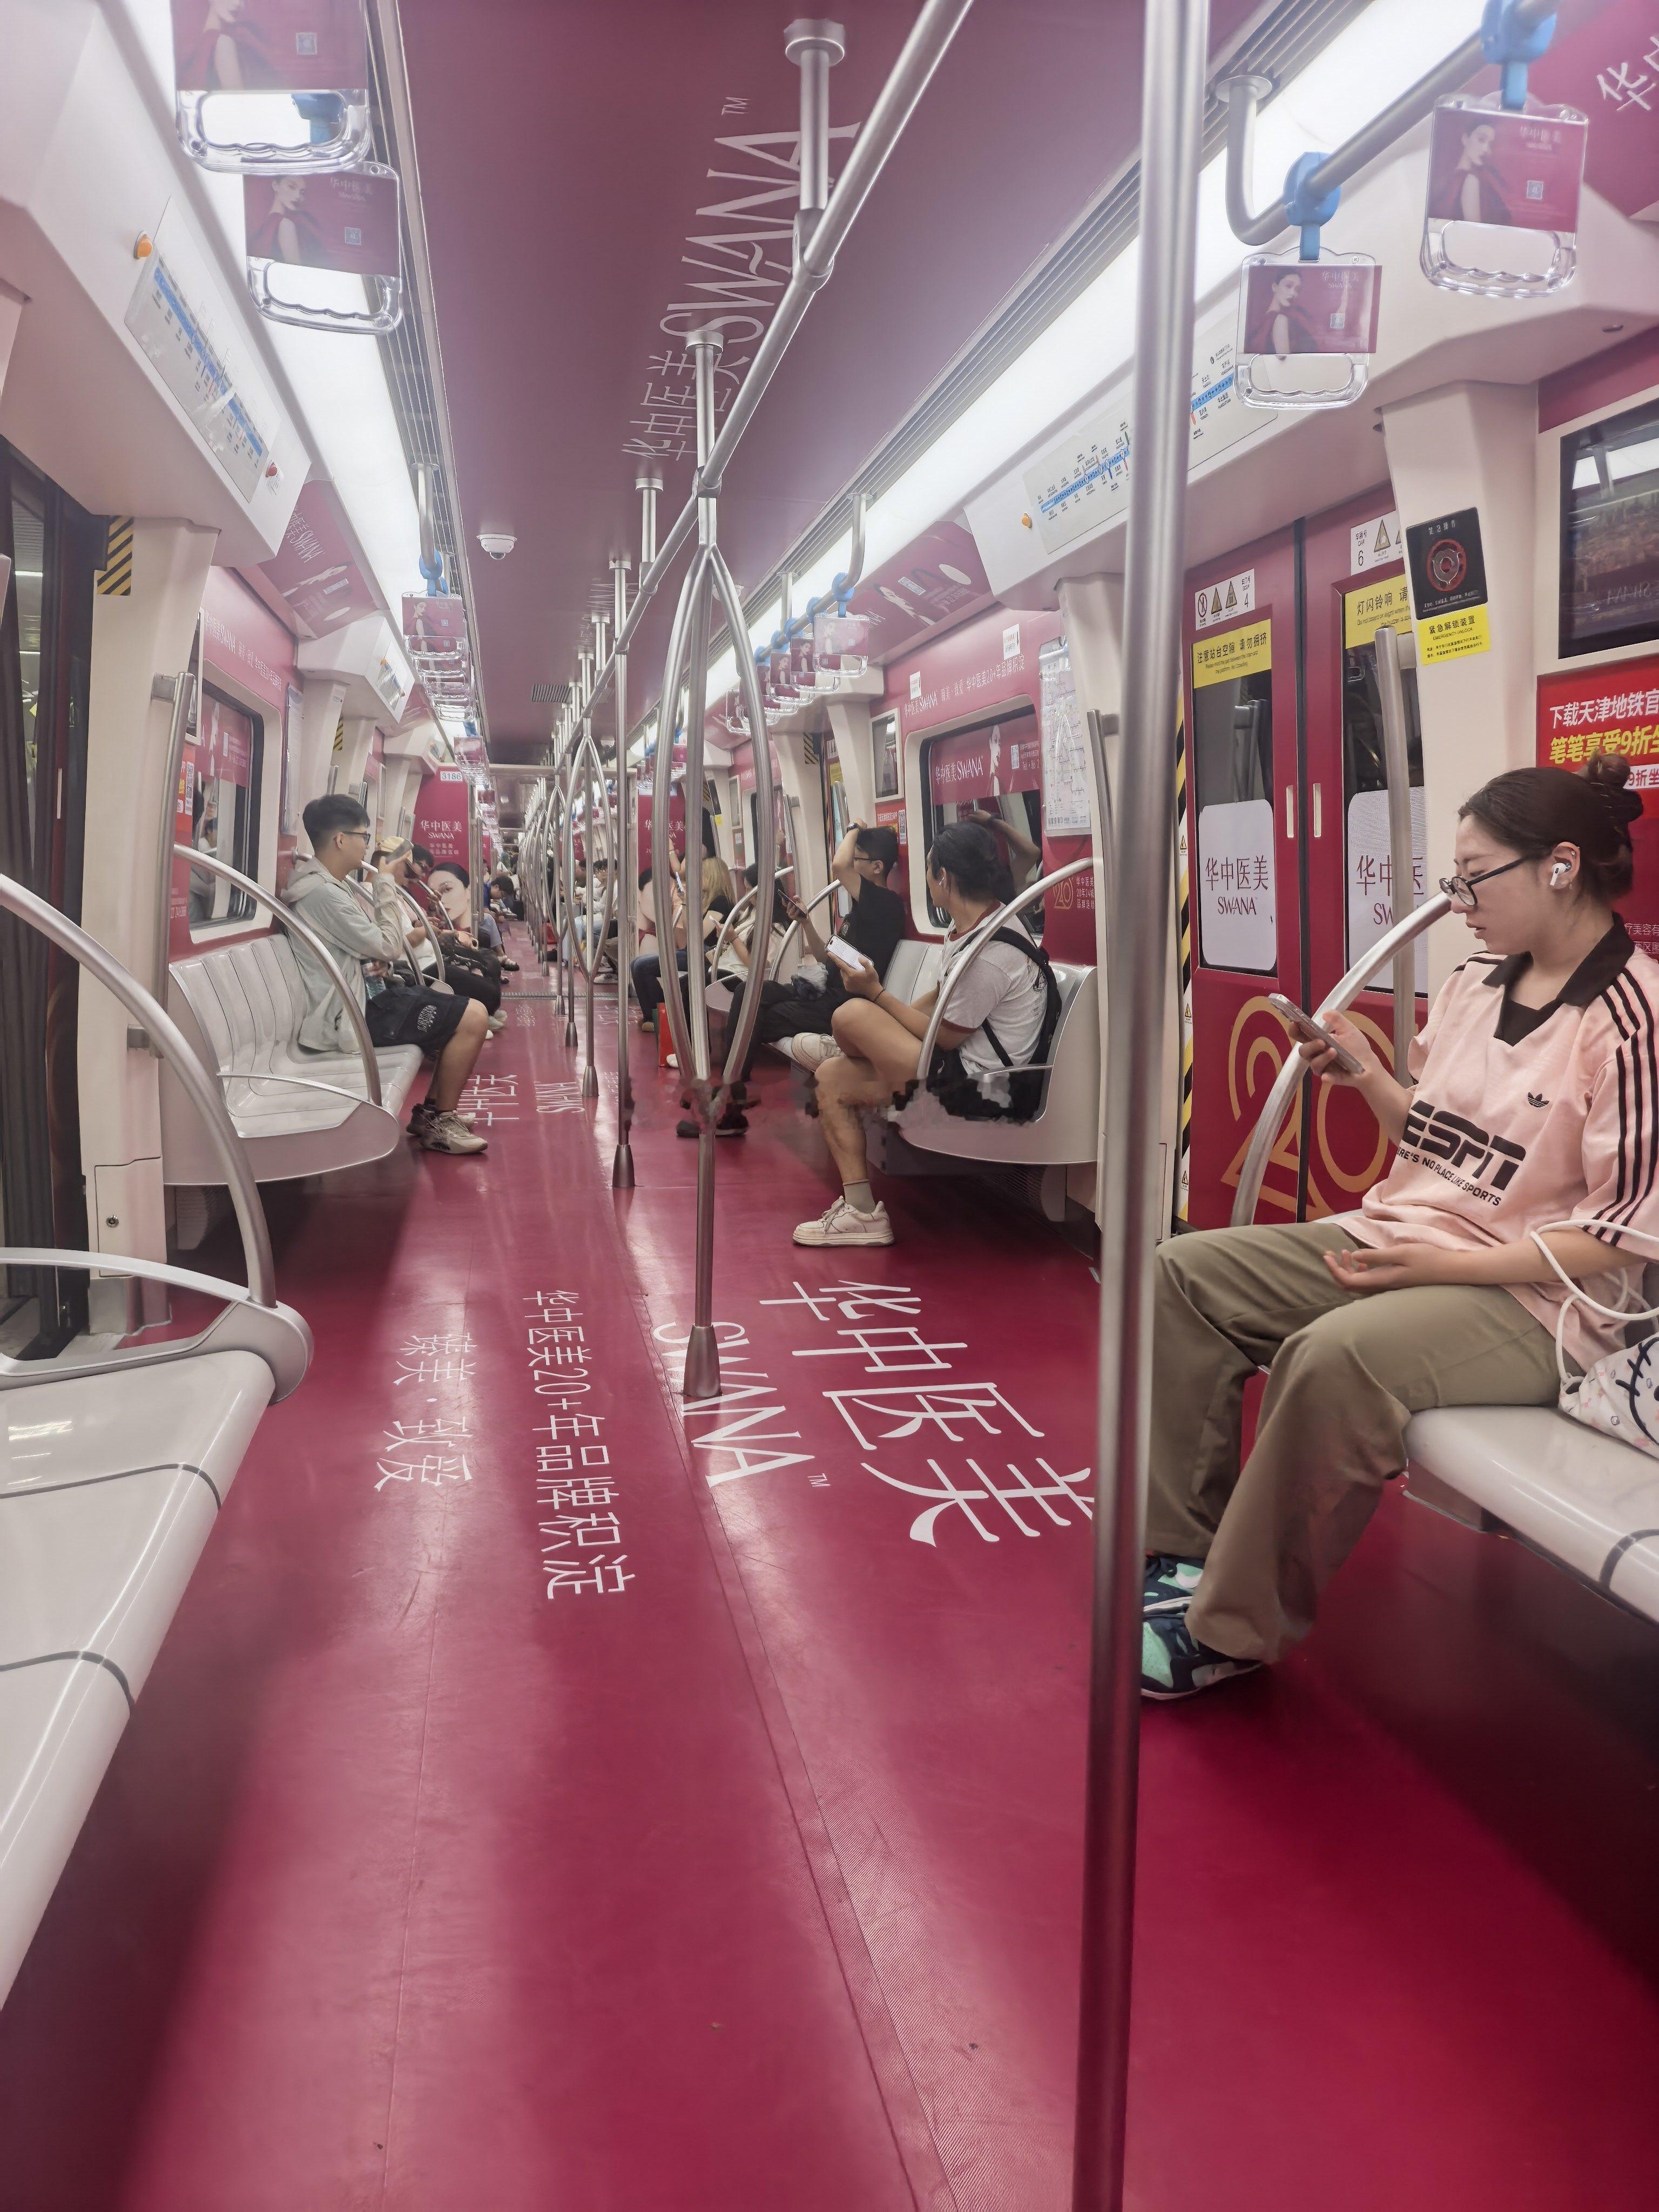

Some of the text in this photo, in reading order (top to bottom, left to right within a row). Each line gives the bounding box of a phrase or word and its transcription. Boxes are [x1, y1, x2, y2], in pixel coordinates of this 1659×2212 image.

[659, 122, 861, 343] SWANA
[1358, 550, 1364, 566] 6
[1244, 593, 1249, 608] 4
[1357, 591, 1392, 616] 灯闪铃响
[919, 691, 938, 712] SWANA
[1549, 688, 1659, 729] 下载天津地铁官
[957, 756, 983, 780] SWANA
[421, 820, 462, 832] 华中医美
[1205, 855, 1268, 891] 华中医美
[1217, 896, 1257, 915] SWANA
[534, 1081, 585, 1113] SWANA
[1401, 1100, 1527, 1191] ESPN
[1397, 1147, 1502, 1206] RE'S NO PLACE LIKE SPORTS
[759, 1280, 1094, 1548] 华中医美
[523, 1290, 636, 1600] 华中医美20+年品牌积淀
